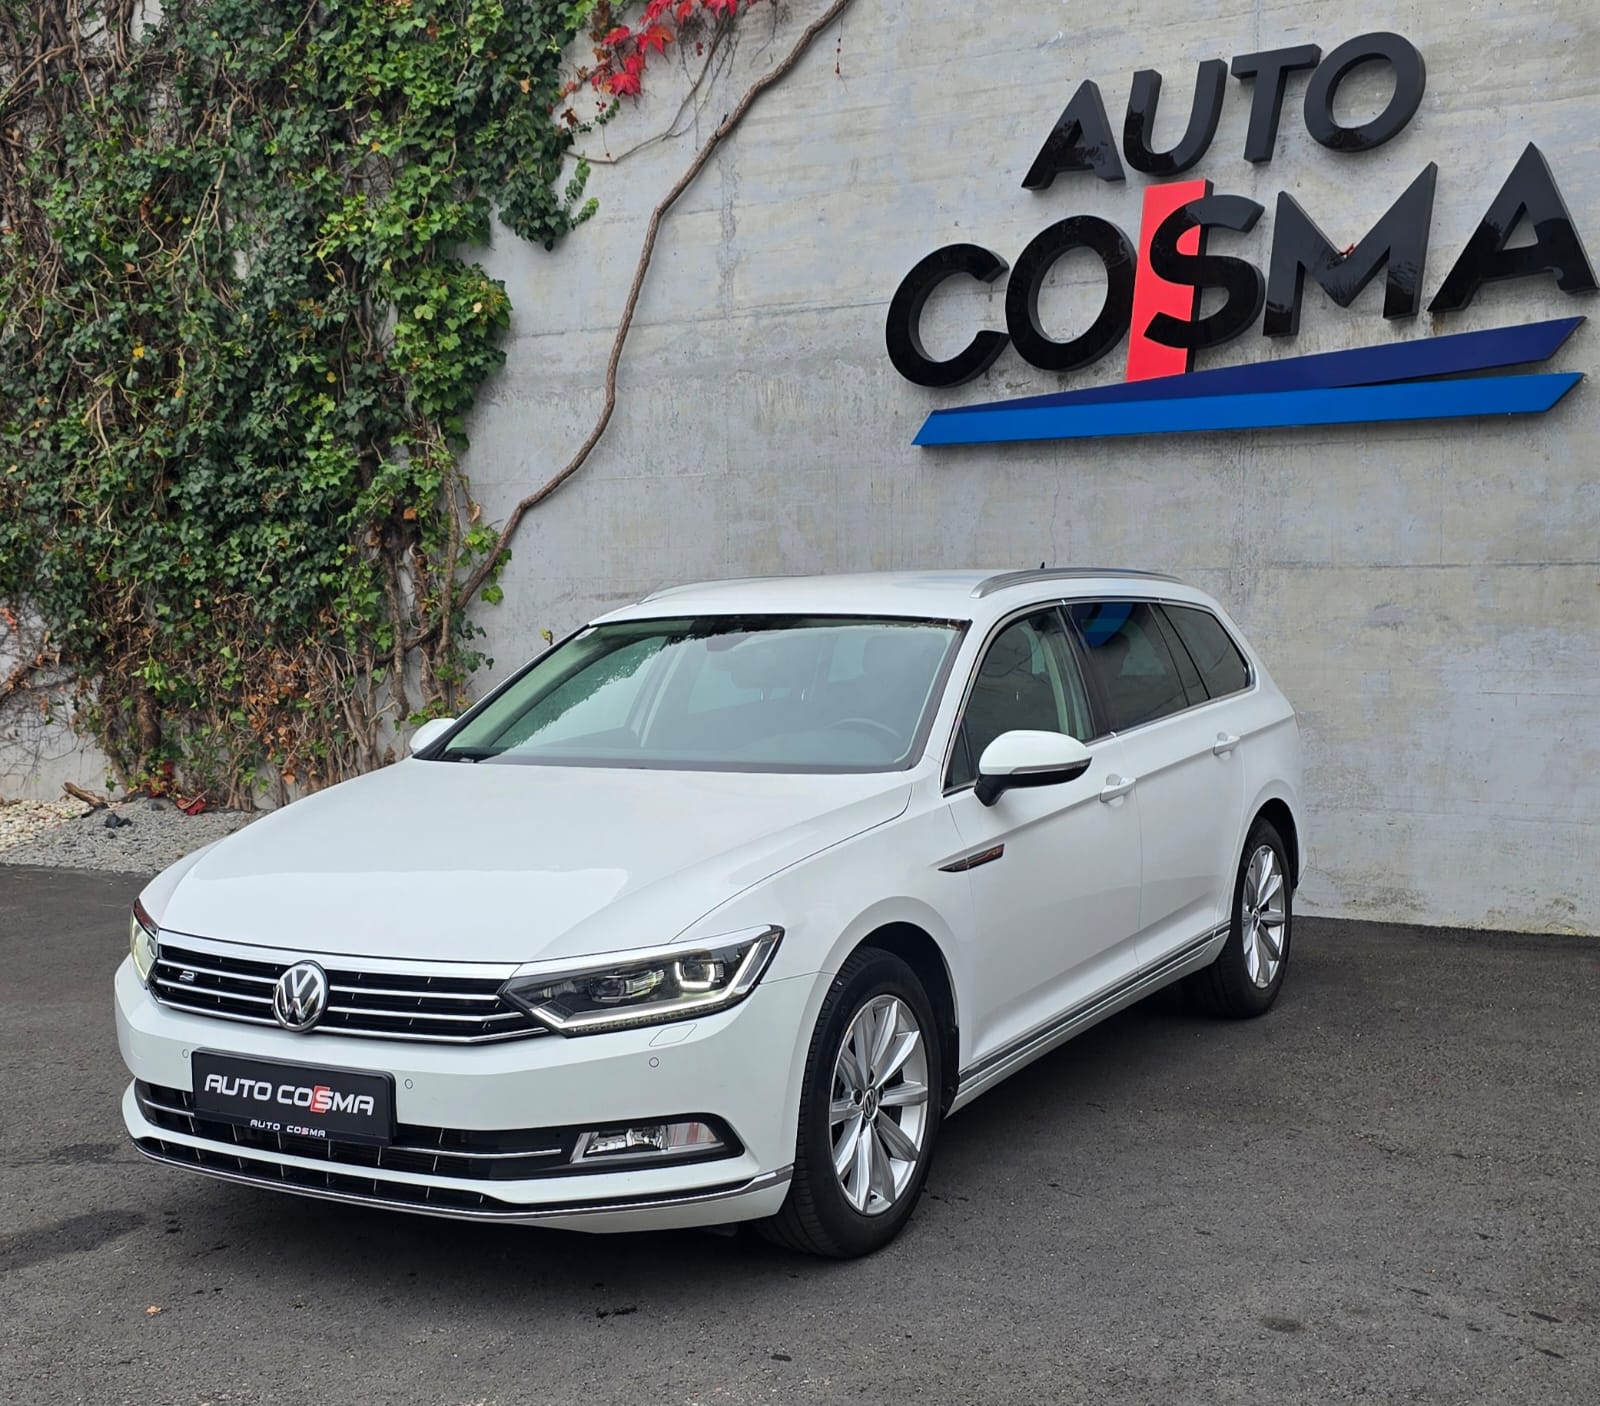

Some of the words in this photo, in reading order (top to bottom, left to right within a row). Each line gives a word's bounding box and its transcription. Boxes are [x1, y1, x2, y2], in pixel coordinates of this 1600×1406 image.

[1021, 31, 1426, 191] AUTO
[885, 142, 1600, 389] COSMA
[205, 1074, 272, 1099] AUTO
[277, 1086, 374, 1116] COSMA
[250, 1119, 281, 1131] AUTO
[286, 1125, 326, 1138] COSMA
